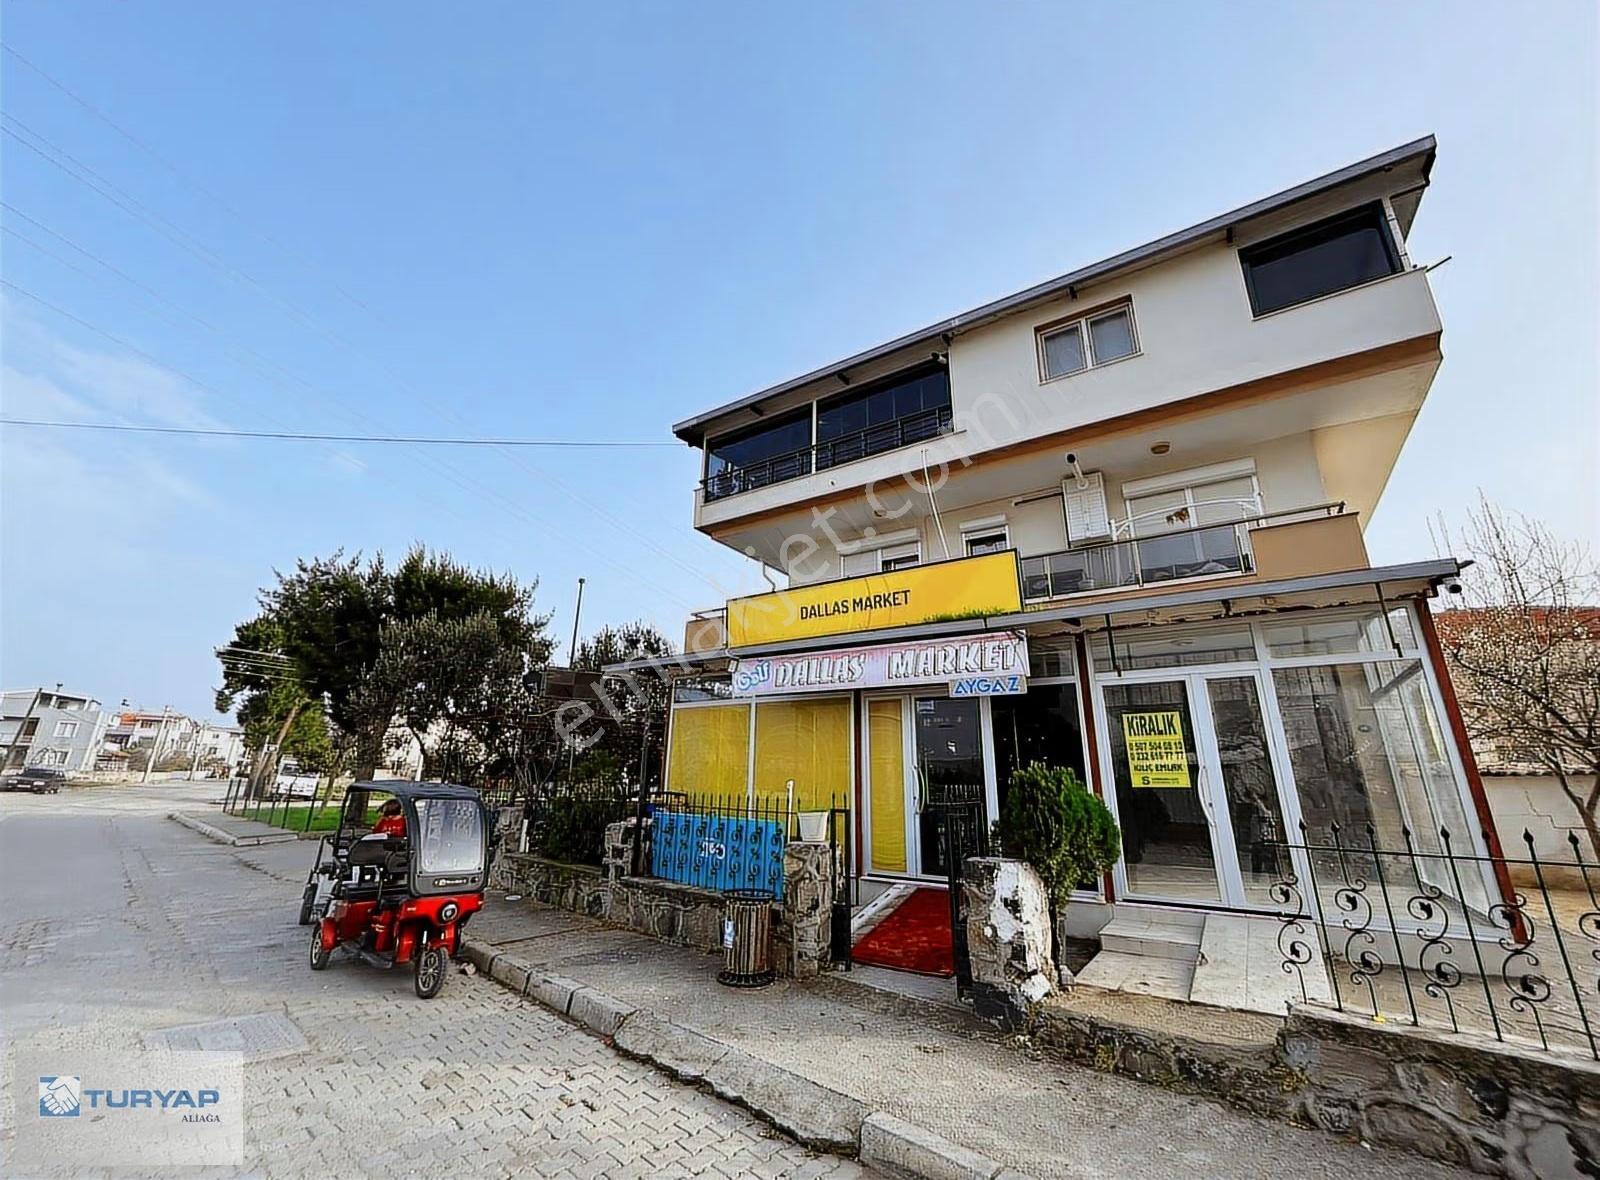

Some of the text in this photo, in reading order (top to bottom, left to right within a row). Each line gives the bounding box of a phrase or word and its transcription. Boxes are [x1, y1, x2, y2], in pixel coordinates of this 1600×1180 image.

[800, 589, 911, 620] DALLAS MARKET
[737, 660, 770, 691] Golf
[775, 639, 1018, 687] DALLAS MARKET
[954, 676, 1019, 694] AYGAZ
